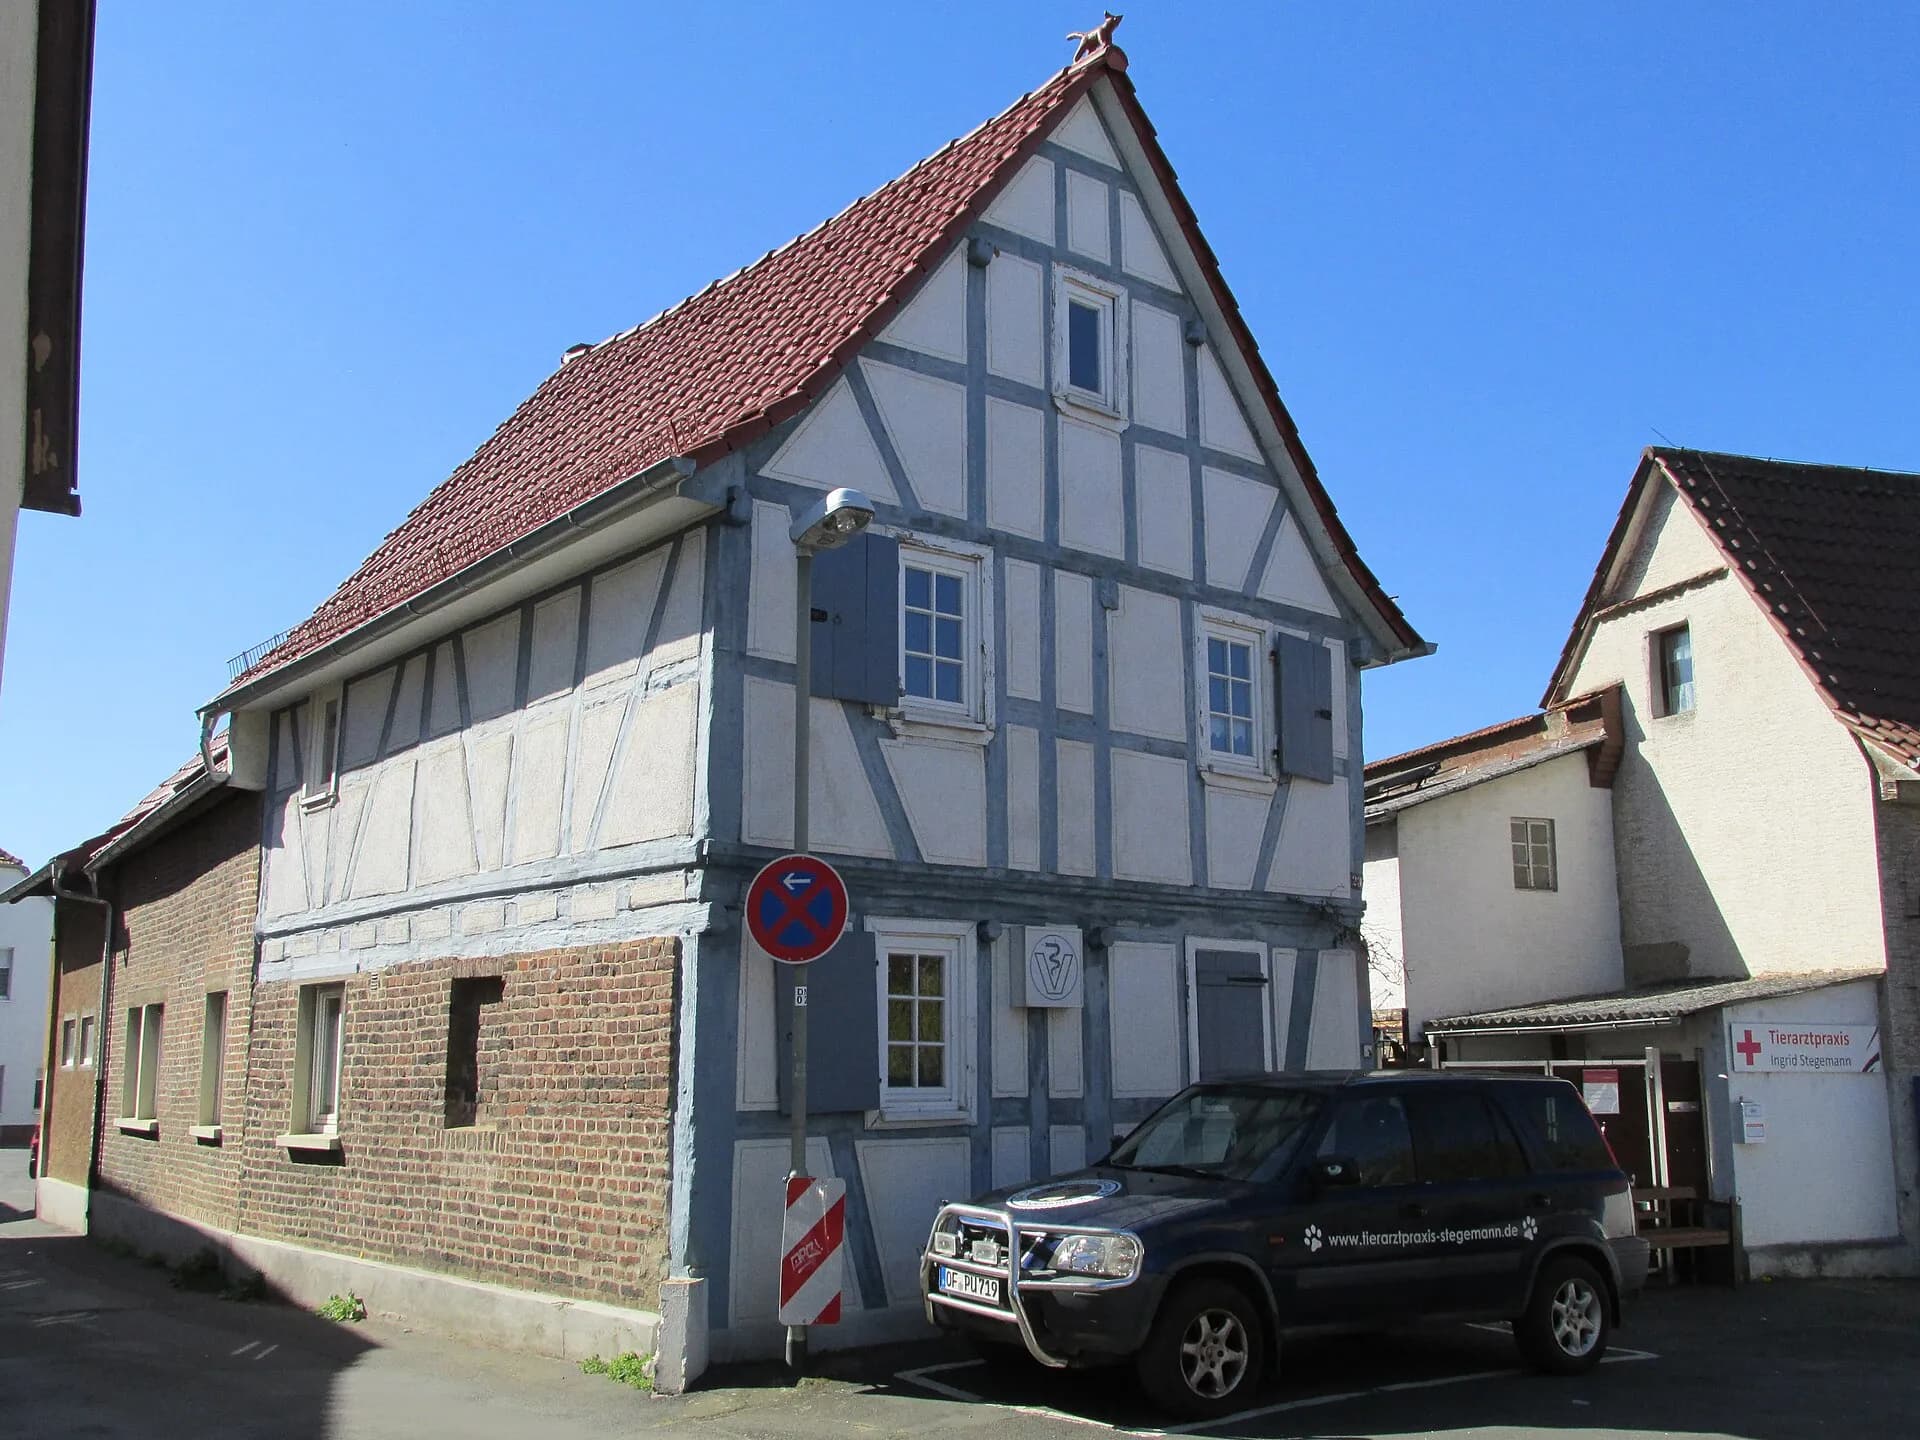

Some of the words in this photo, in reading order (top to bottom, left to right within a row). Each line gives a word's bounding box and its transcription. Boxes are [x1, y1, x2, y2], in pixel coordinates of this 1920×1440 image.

[1768, 1029, 1850, 1048] Tierarztpraxis
[1770, 1054, 1798, 1069] Ingrid
[1799, 1054, 1852, 1069] Stegemann
[1328, 1224, 1519, 1247] www.tierarztpraxis-stegemann.de
